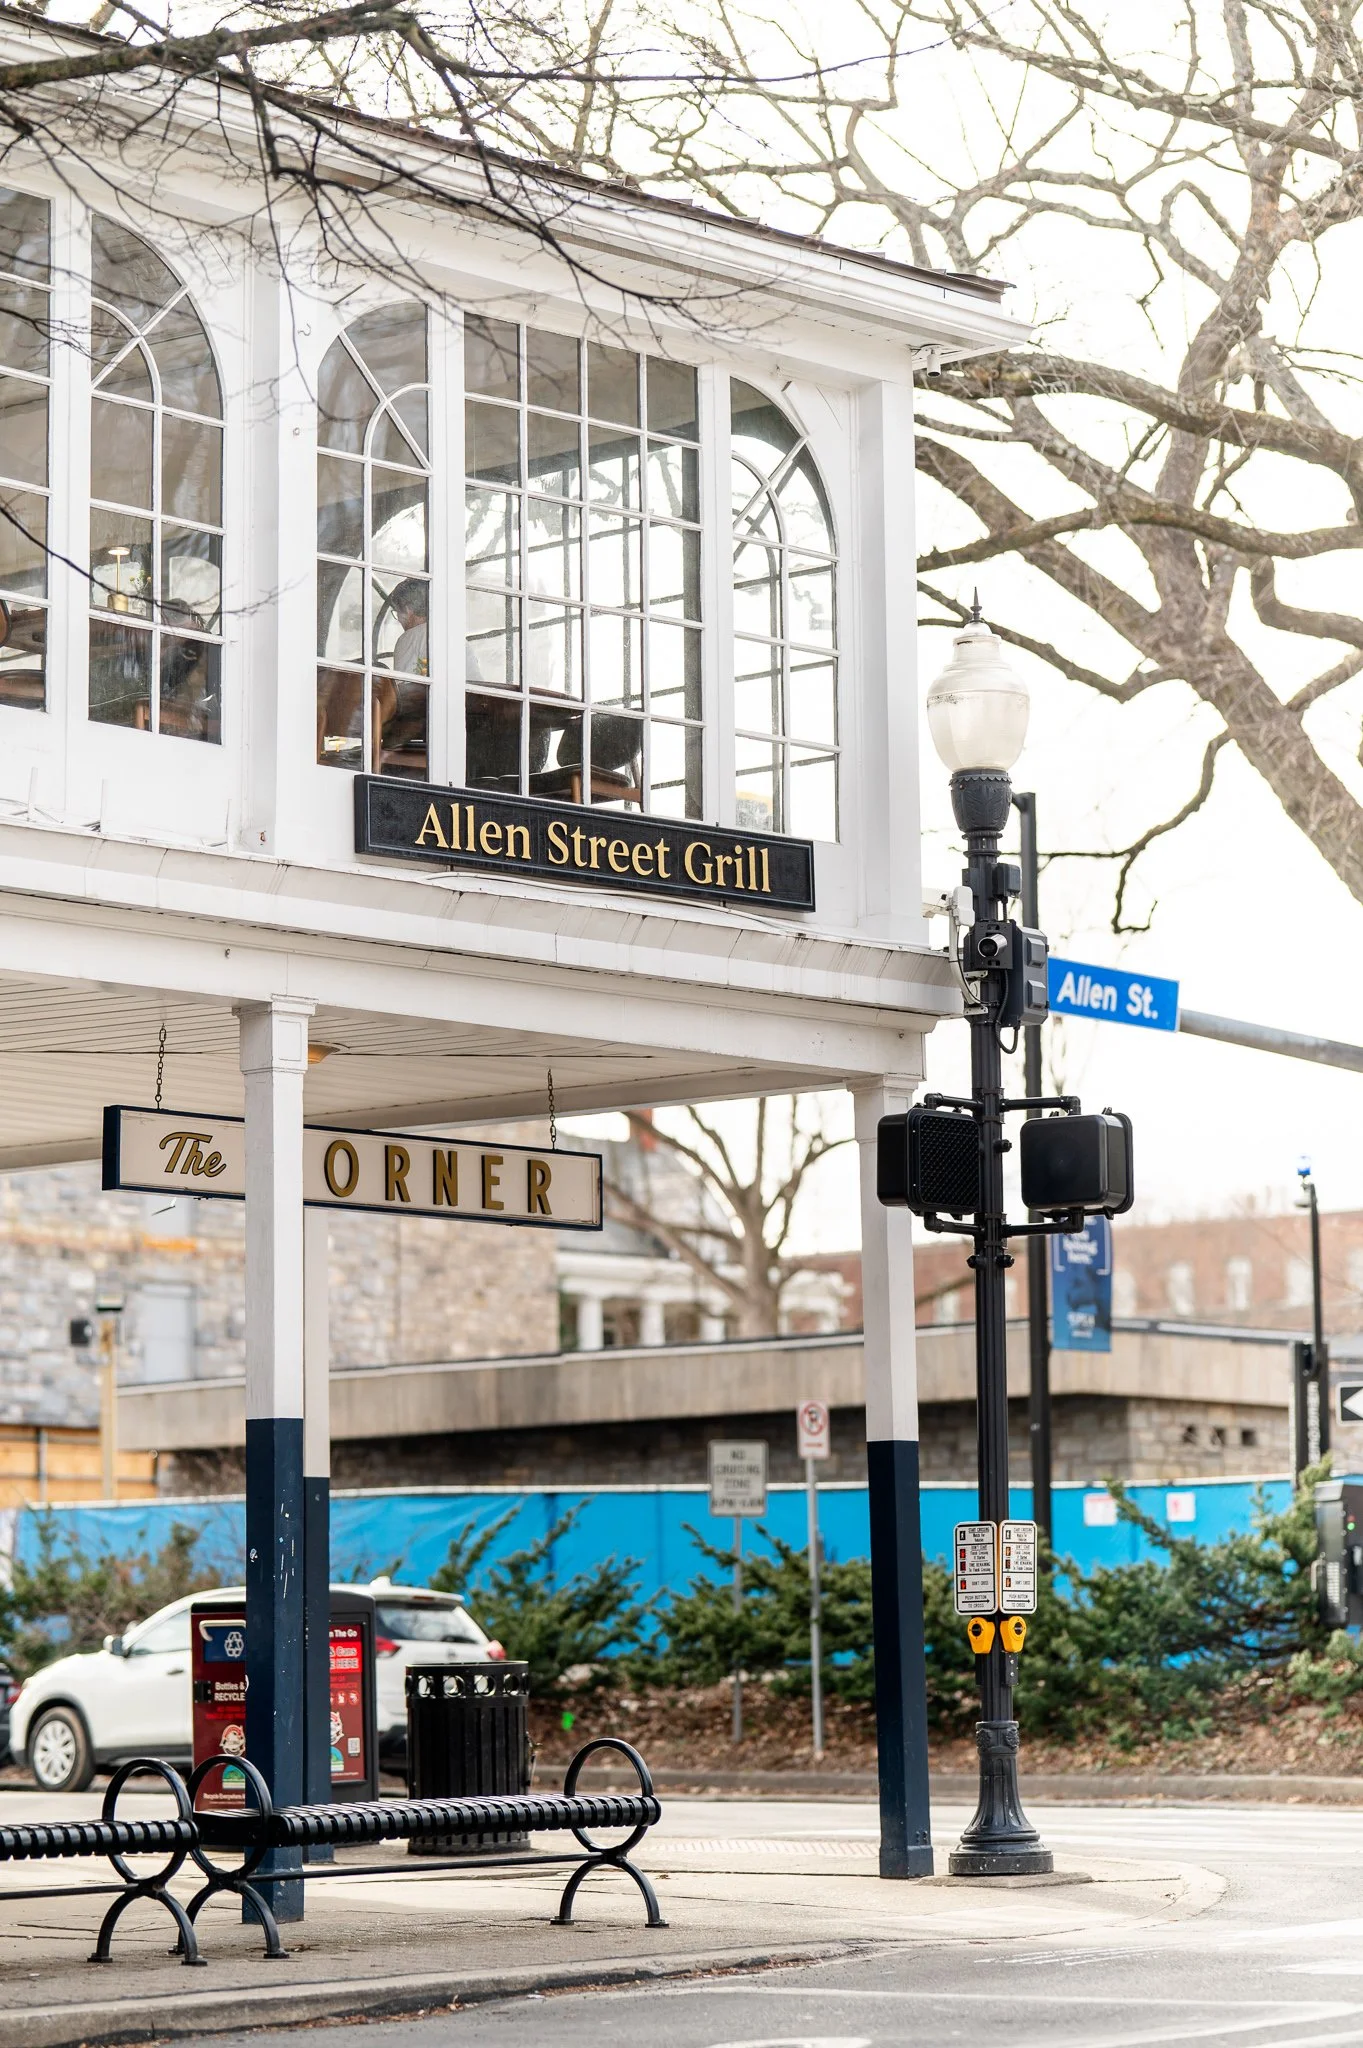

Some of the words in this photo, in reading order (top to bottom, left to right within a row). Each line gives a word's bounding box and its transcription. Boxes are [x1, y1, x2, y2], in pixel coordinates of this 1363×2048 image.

[415, 802, 531, 859] Allen
[546, 821, 671, 879] Street
[684, 842, 771, 893] Grill
[1057, 971, 1117, 1012] Allen
[1126, 983, 1158, 1020] St.
[159, 1131, 227, 1178] The
[324, 1140, 552, 1215] ORNER
[334, 1629, 346, 1638] The
[347, 1629, 357, 1638] Go
[336, 1658, 359, 1669] HERE
[215, 1682, 238, 1690] Bottles
[214, 1692, 245, 1701] RECYCLE
